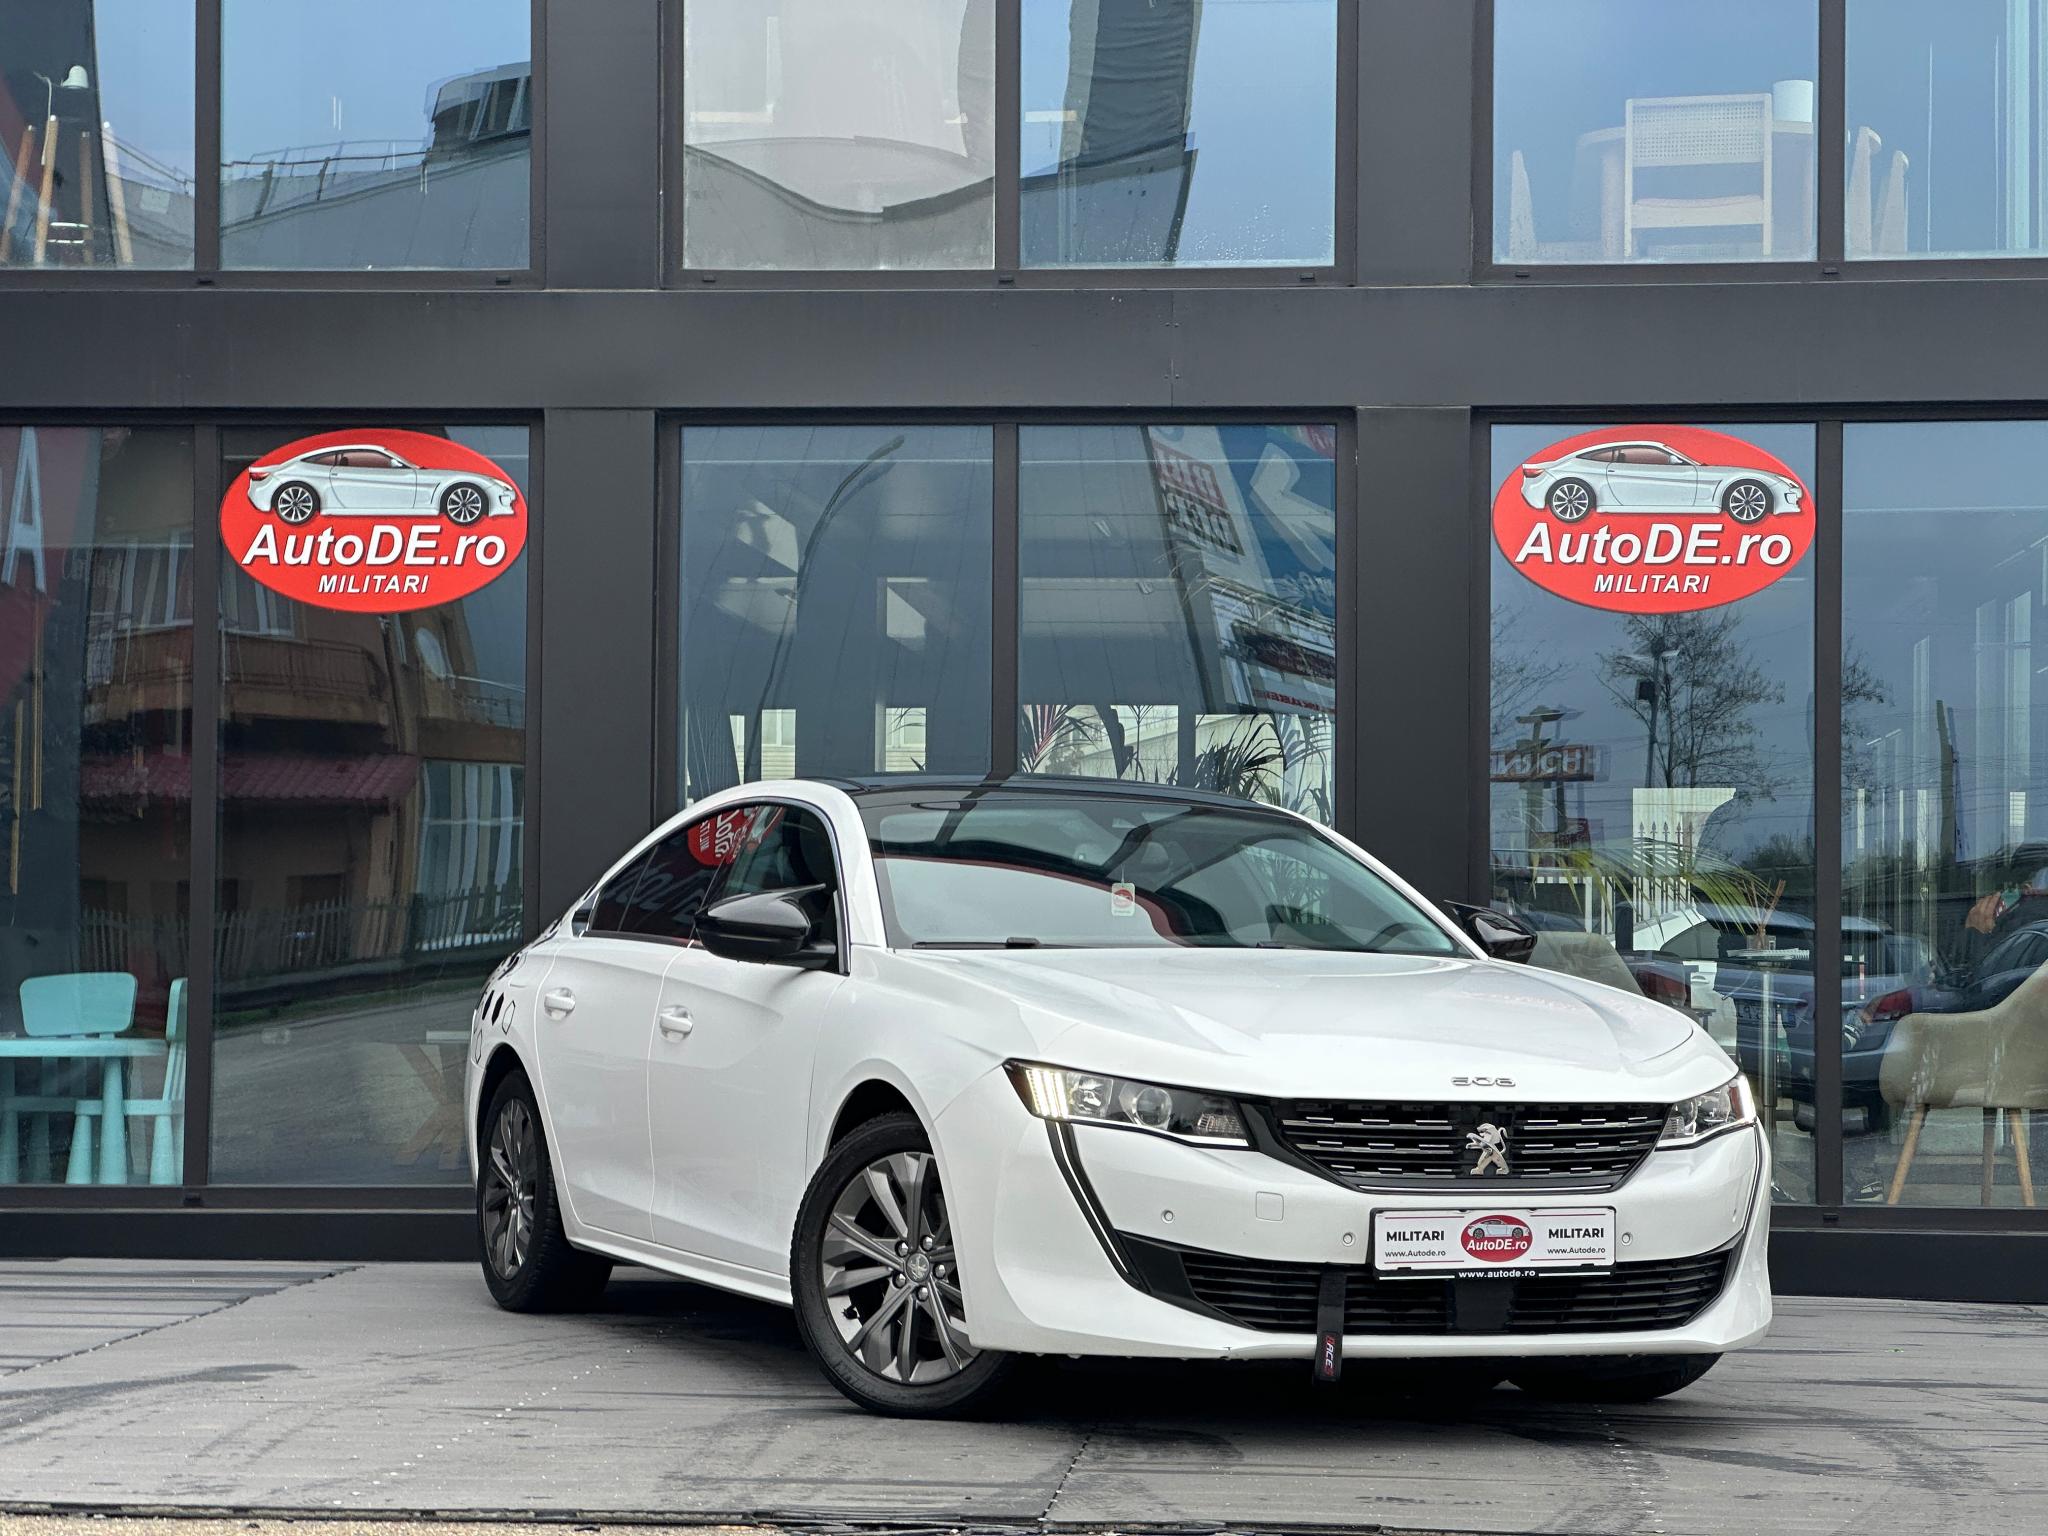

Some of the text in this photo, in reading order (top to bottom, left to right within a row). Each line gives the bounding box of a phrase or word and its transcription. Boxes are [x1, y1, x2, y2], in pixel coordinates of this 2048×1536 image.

[241, 524, 506, 566] AutoDE.ro
[1515, 522, 1792, 565] AutoDE.ro
[318, 575, 429, 593] MILITARI
[1593, 575, 1710, 593] MILITARI
[1451, 1076, 1516, 1088] 508
[1386, 1230, 1445, 1242] MILITARI
[1548, 1228, 1605, 1239] MILITARI
[1466, 1238, 1528, 1251] AutoDE.ro
[1547, 1246, 1606, 1255] www.Autode.ro
[1385, 1248, 1446, 1257] www.Autode.ro
[1458, 1268, 1536, 1279] www.autode.ro
